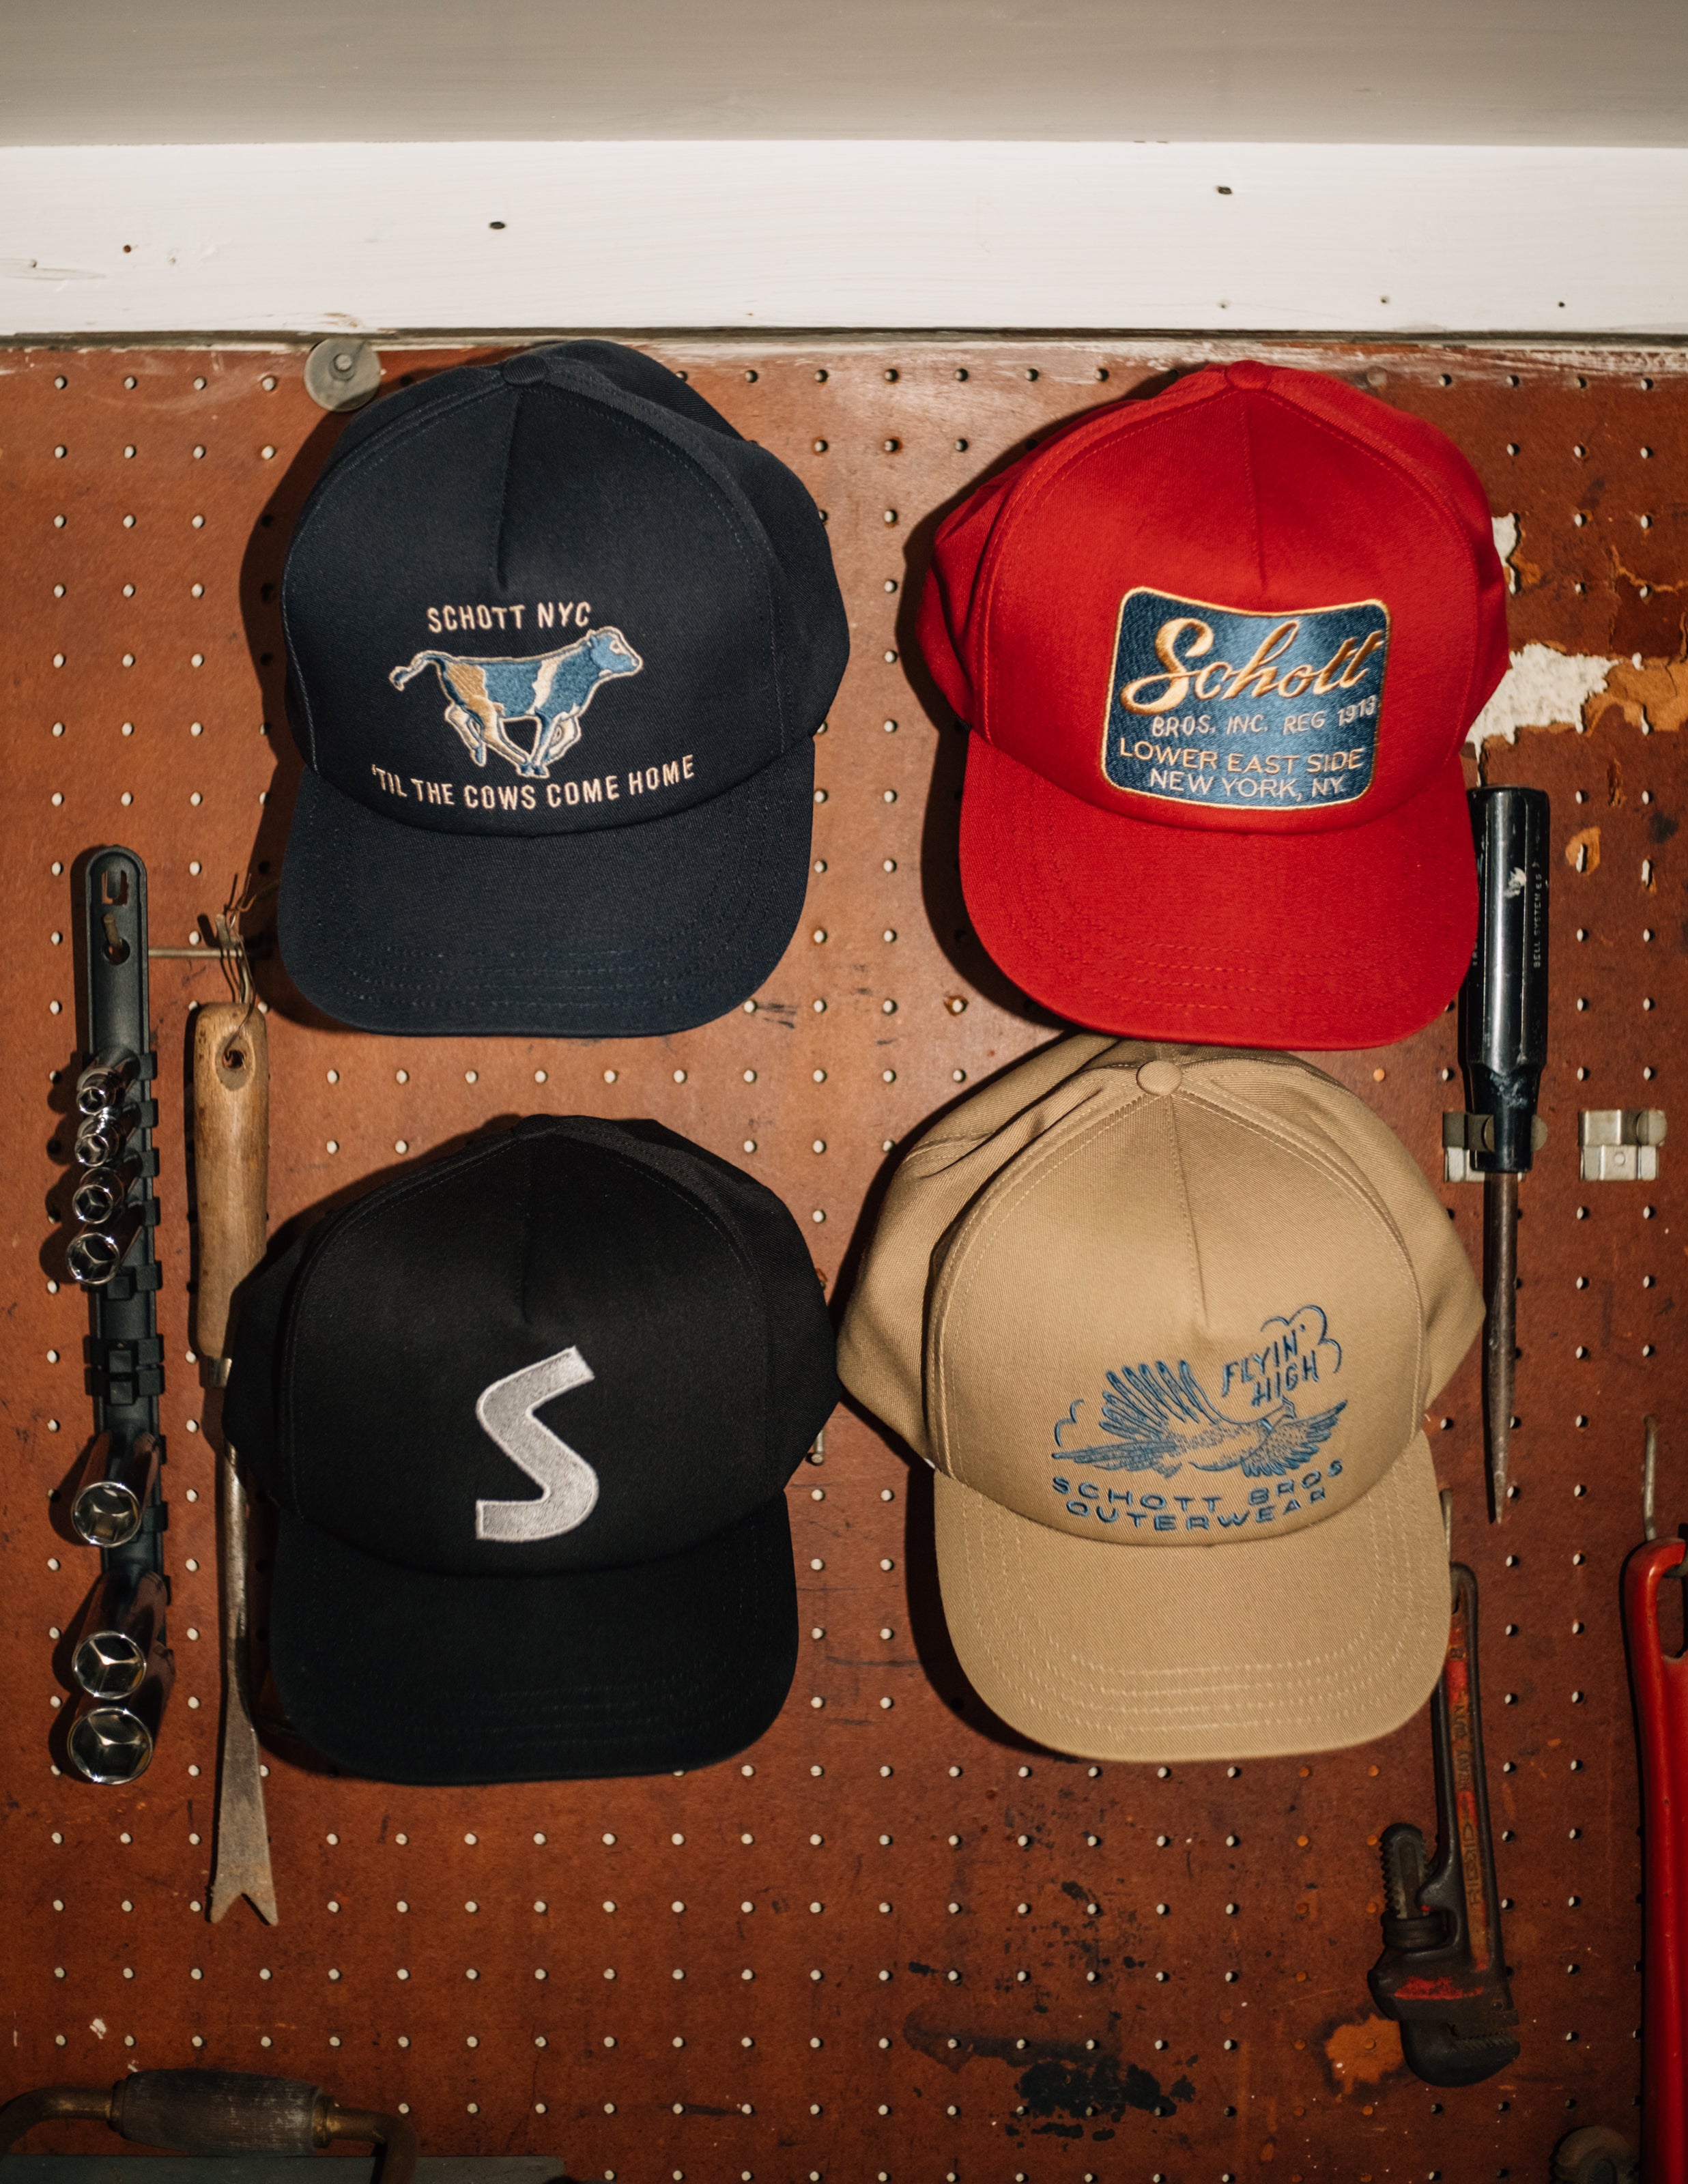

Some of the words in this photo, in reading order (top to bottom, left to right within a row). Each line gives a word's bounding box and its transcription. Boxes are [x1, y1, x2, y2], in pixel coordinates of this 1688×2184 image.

[427, 604, 526, 633] SCHOTT
[537, 601, 591, 629] NYC
[1120, 617, 1384, 716] Schott
[1226, 713, 1269, 735] INC.
[1283, 710, 1327, 736] REG
[1336, 694, 1377, 727] 1913
[1119, 737, 1218, 771] LOWER
[1227, 753, 1300, 775] EAST
[1306, 747, 1364, 775] SIDE
[371, 764, 408, 798] 'TIL
[410, 777, 455, 805] THE
[464, 784, 537, 811] COWS
[546, 775, 620, 809] COME
[628, 753, 695, 796] HOME
[1149, 768, 1214, 796] NEW
[1221, 777, 1304, 803] YORK,
[1533, 892, 1542, 936] SYSTEM
[1533, 940, 1541, 968] BELL
[1250, 1349, 1320, 1407] HIGH
[475, 1345, 600, 1543] S
[1052, 1476, 1222, 1512] SCHOTT
[1248, 1459, 1343, 1506] BROS
[1065, 1487, 1326, 1532] OUTERWEAR
